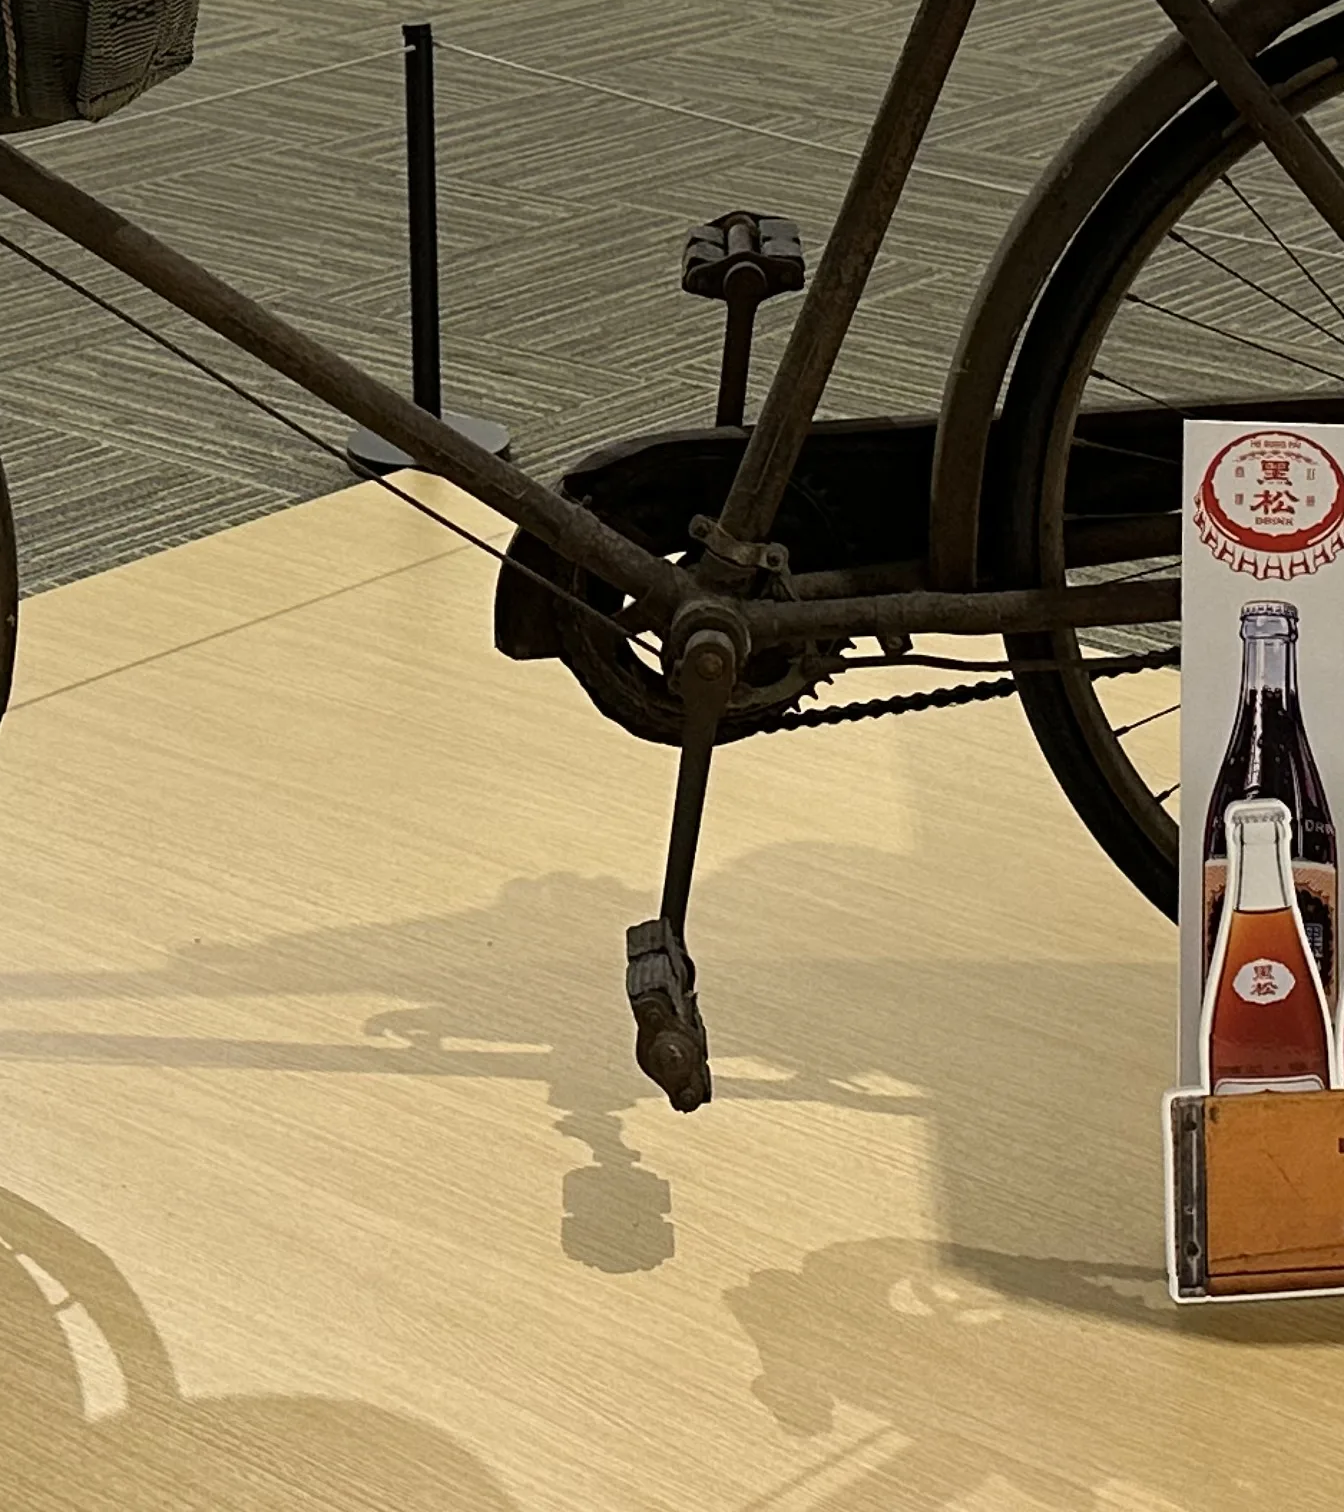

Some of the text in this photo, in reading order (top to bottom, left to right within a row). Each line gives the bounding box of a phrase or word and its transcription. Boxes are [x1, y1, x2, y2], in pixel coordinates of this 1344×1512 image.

[1249, 459, 1300, 515] 黑松
[1255, 517, 1294, 526] DRINK
[1250, 965, 1278, 996] 黑松
